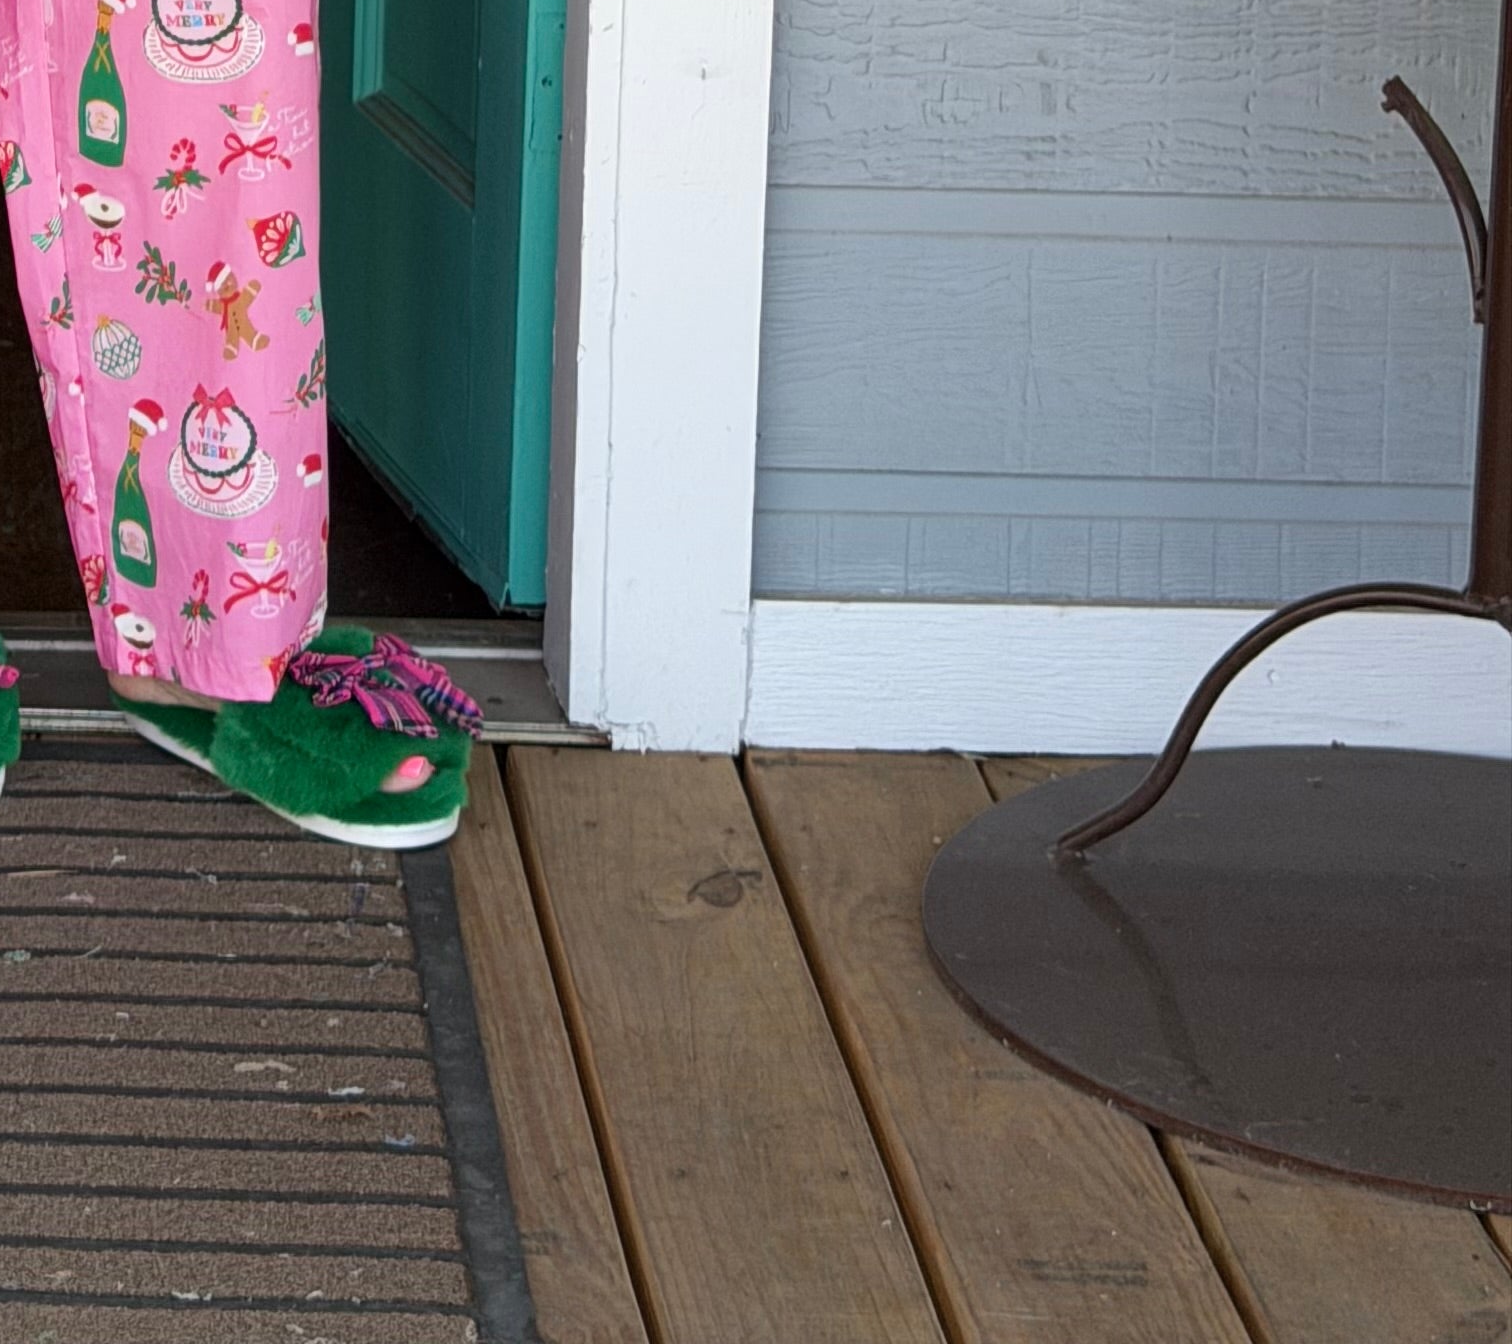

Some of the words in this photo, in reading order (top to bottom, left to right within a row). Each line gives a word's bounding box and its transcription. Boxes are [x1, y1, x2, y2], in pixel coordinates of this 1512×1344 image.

[174, 0, 213, 12] VERY
[165, 13, 225, 27] MERRY
[198, 427, 228, 443] VERY
[190, 440, 238, 460] MERRY
